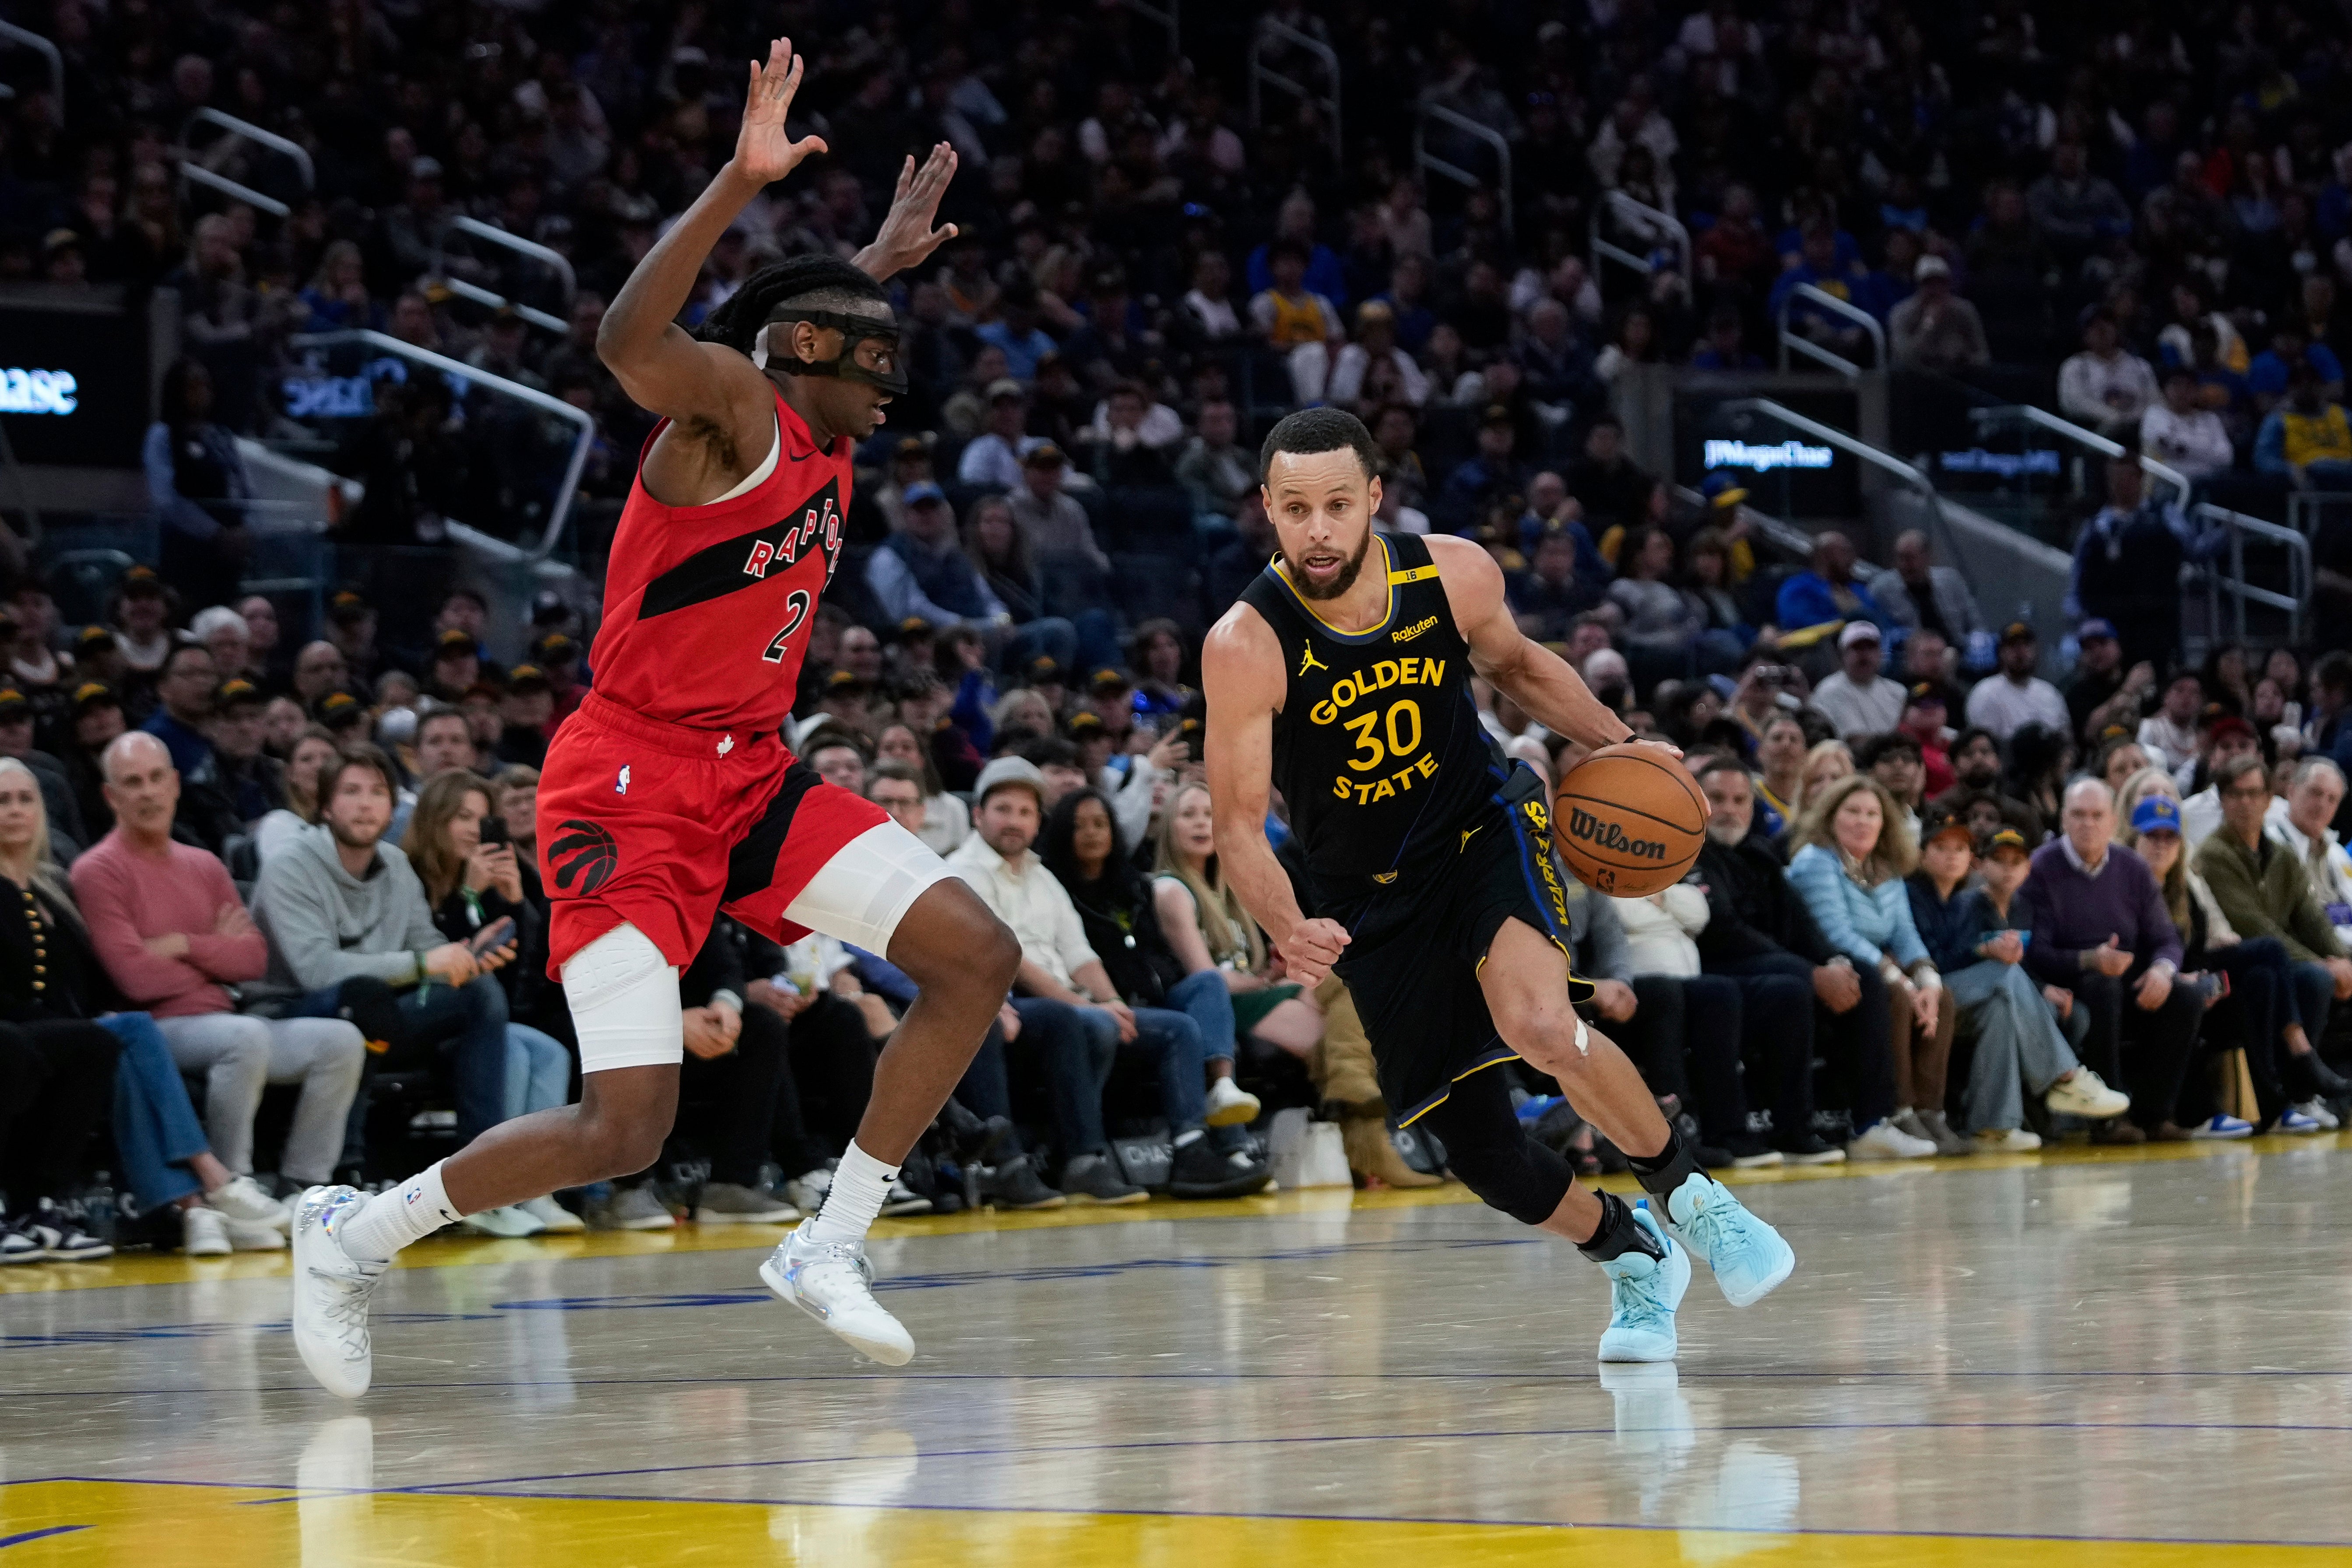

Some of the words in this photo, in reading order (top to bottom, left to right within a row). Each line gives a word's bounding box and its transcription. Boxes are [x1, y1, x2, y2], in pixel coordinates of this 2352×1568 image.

[0, 367, 78, 416] ase
[1406, 570, 1417, 580] 16
[762, 589, 810, 664] 2
[1391, 615, 1438, 643] Rakuten
[1310, 657, 1446, 725] GOLDEN
[1343, 699, 1422, 771] 30
[1333, 752, 1439, 805] STATE
[1569, 806, 1666, 861] Wilson
